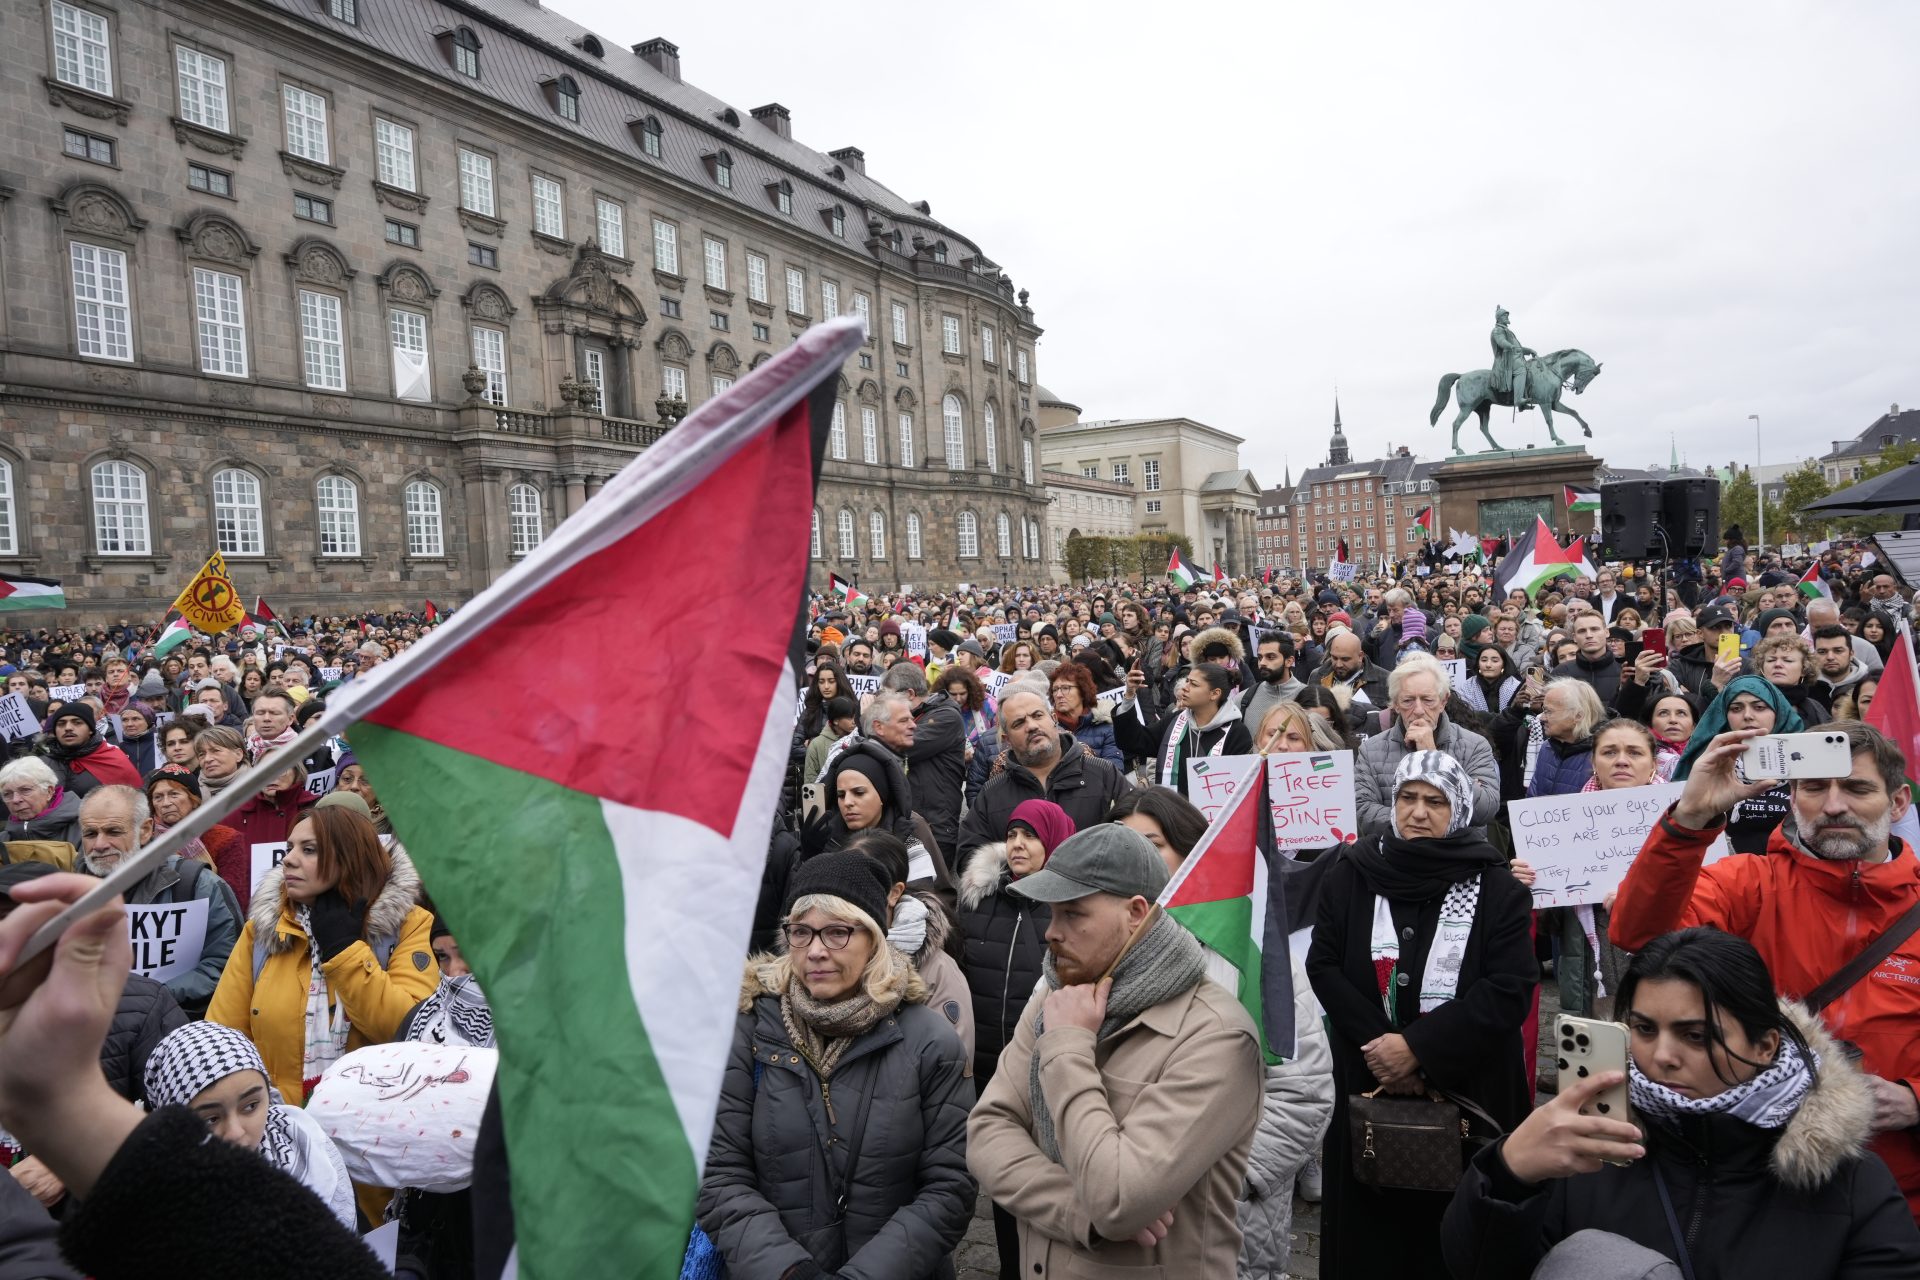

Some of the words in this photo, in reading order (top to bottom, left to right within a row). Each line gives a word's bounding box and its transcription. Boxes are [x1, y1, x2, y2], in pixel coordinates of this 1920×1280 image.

[323, 669, 341, 677] BESK
[848, 677, 881, 692] PHÆV
[1166, 715, 1187, 769] PALESTINE
[1274, 761, 1342, 793] FREE
[1519, 808, 1571, 827] CLOSE
[1626, 799, 1660, 824] eyes
[1767, 804, 1787, 812] SEA
[1572, 830, 1600, 842] ARE
[1611, 824, 1653, 839] SLEEP
[1582, 864, 1609, 875] ARE
[131, 908, 187, 940] KYT
[131, 938, 177, 970] ILE
